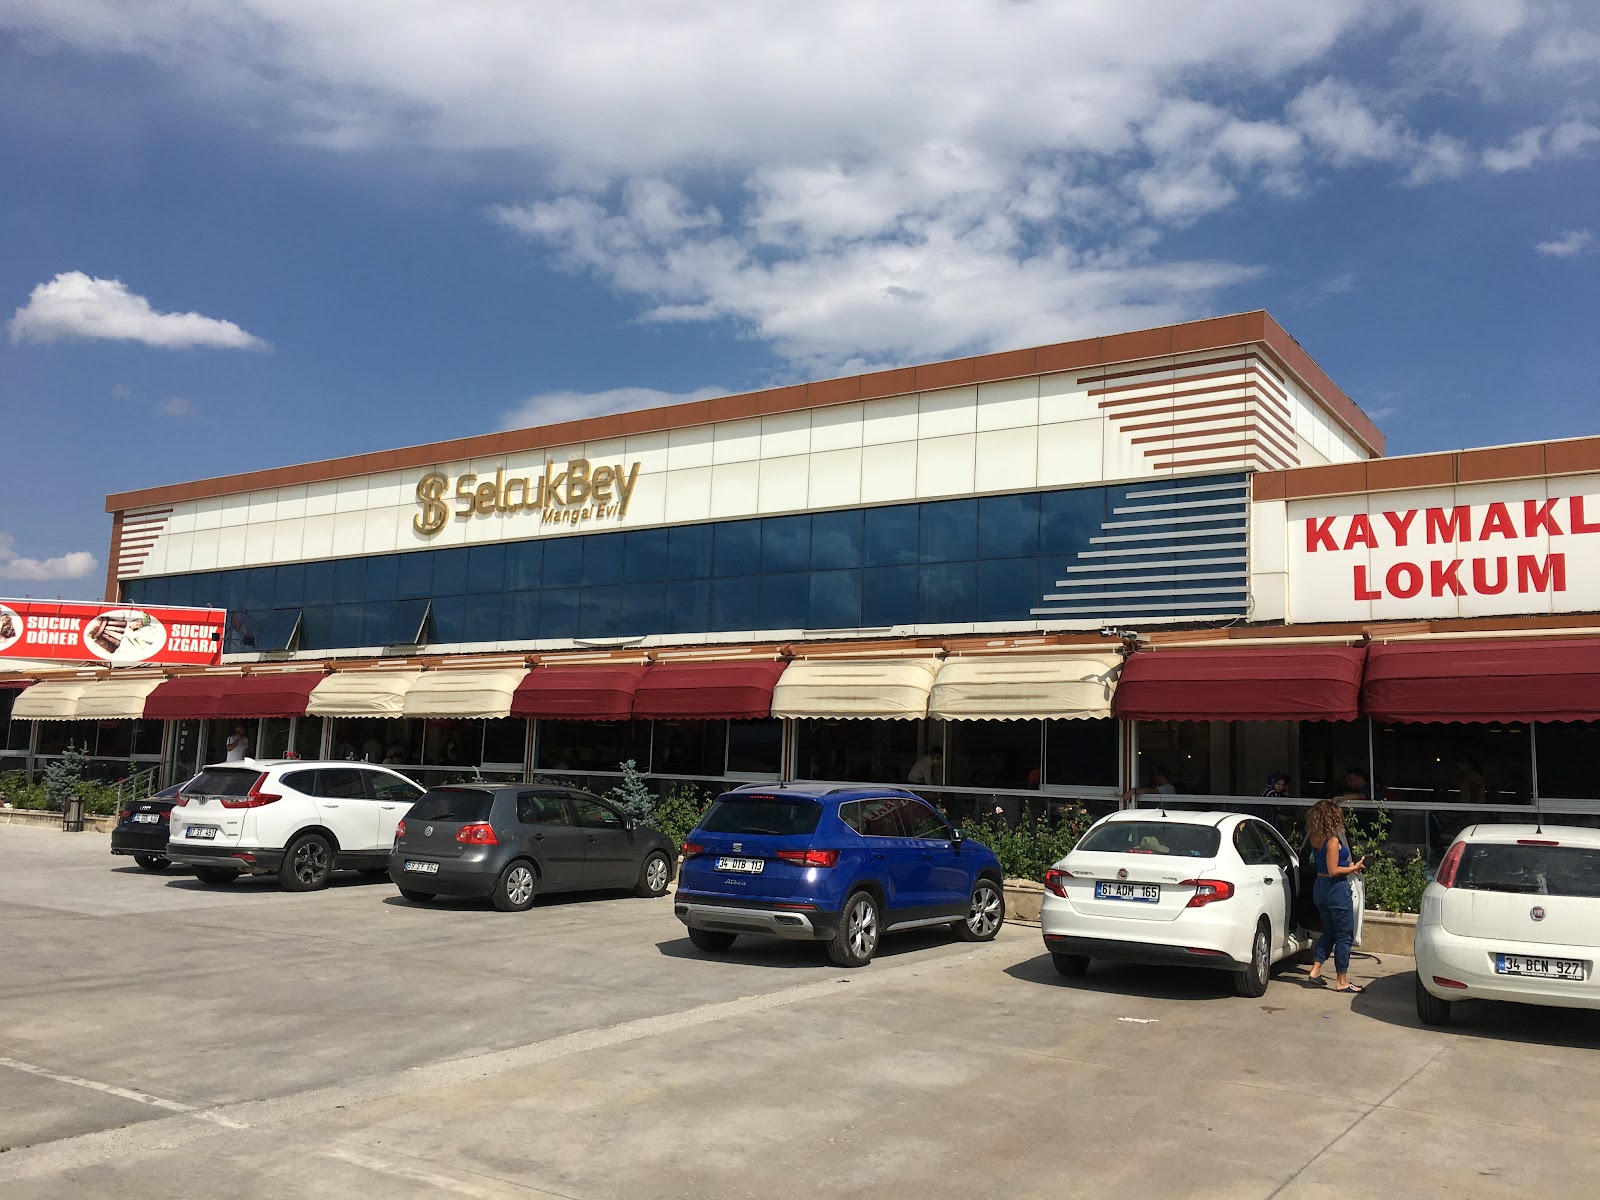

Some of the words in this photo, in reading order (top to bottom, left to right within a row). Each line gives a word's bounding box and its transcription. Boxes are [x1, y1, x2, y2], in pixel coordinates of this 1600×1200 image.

[542, 504, 594, 524] Mangal
[596, 501, 619, 518] Evi
[1306, 496, 1600, 552] KAYMAKL
[1354, 553, 1566, 601] LOKUM
[27, 616, 81, 631] SUCUK
[26, 629, 79, 646] DÖNER
[168, 637, 218, 653] IZGARA
[720, 857, 728, 867] 34
[751, 860, 763, 870] 113
[1102, 883, 1112, 895] 61
[1116, 885, 1134, 896] ADM
[1141, 886, 1157, 898] 165
[1506, 957, 1520, 970] 34
[1526, 959, 1549, 972] BCN
[1556, 961, 1579, 975] 927
